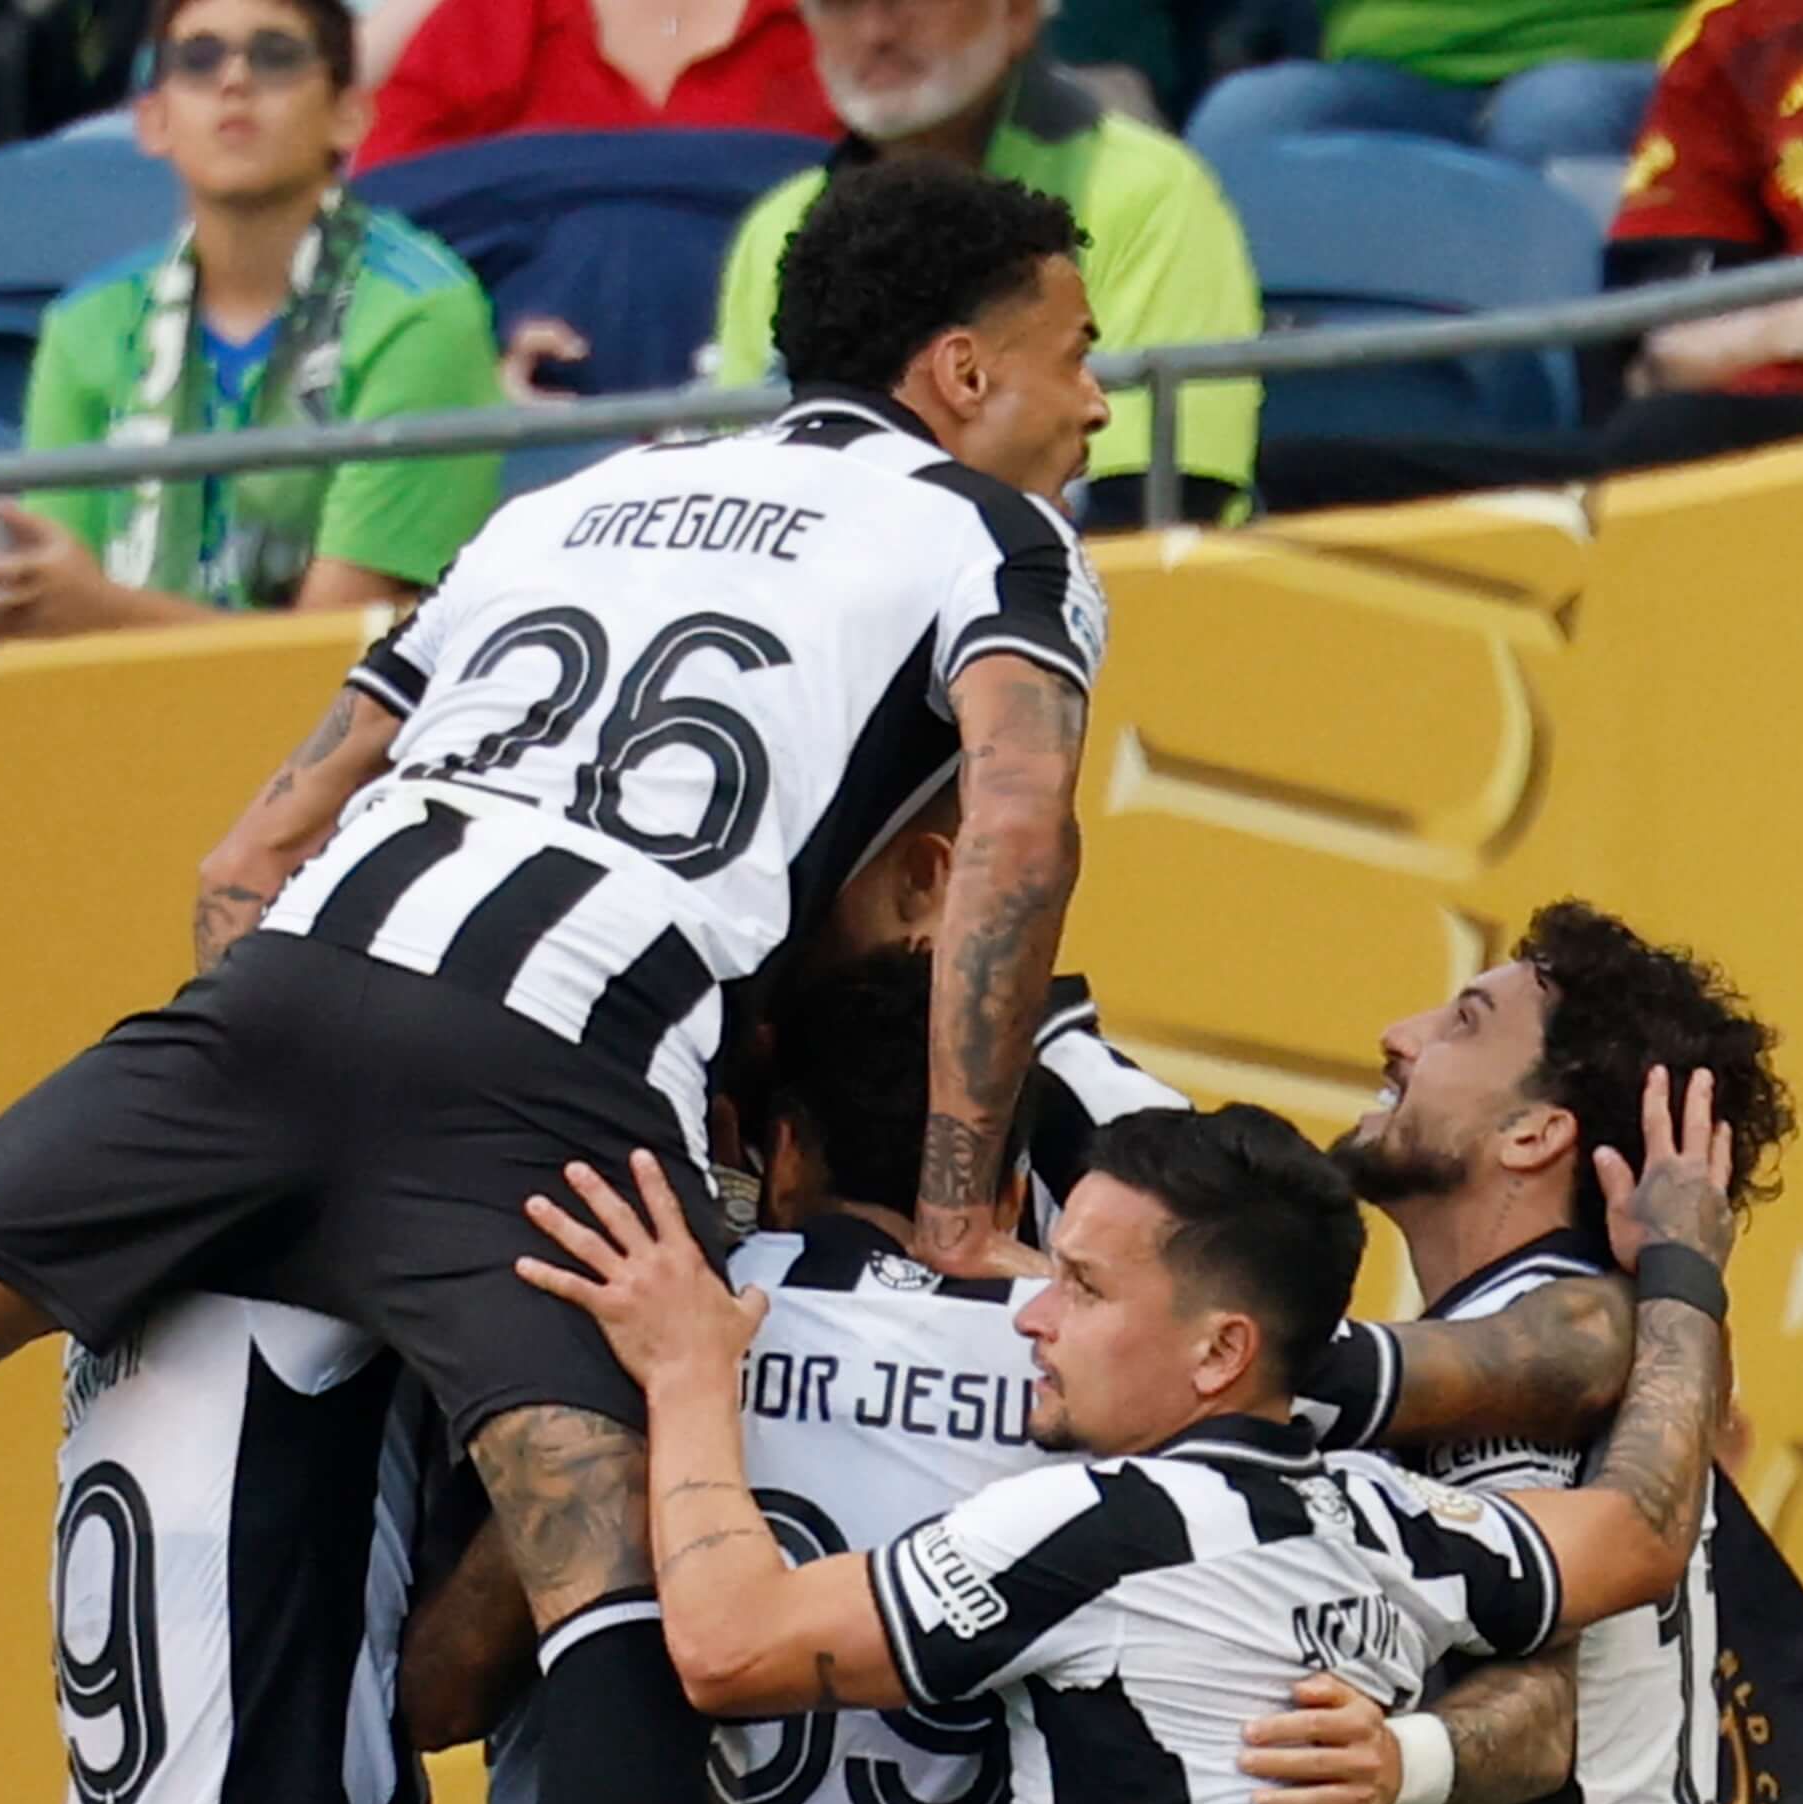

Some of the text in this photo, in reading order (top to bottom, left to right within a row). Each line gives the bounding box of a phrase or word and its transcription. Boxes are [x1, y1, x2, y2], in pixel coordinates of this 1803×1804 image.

[563, 494, 827, 562] GREGORE
[400, 604, 796, 882] 26
[739, 1349, 839, 1422] OR
